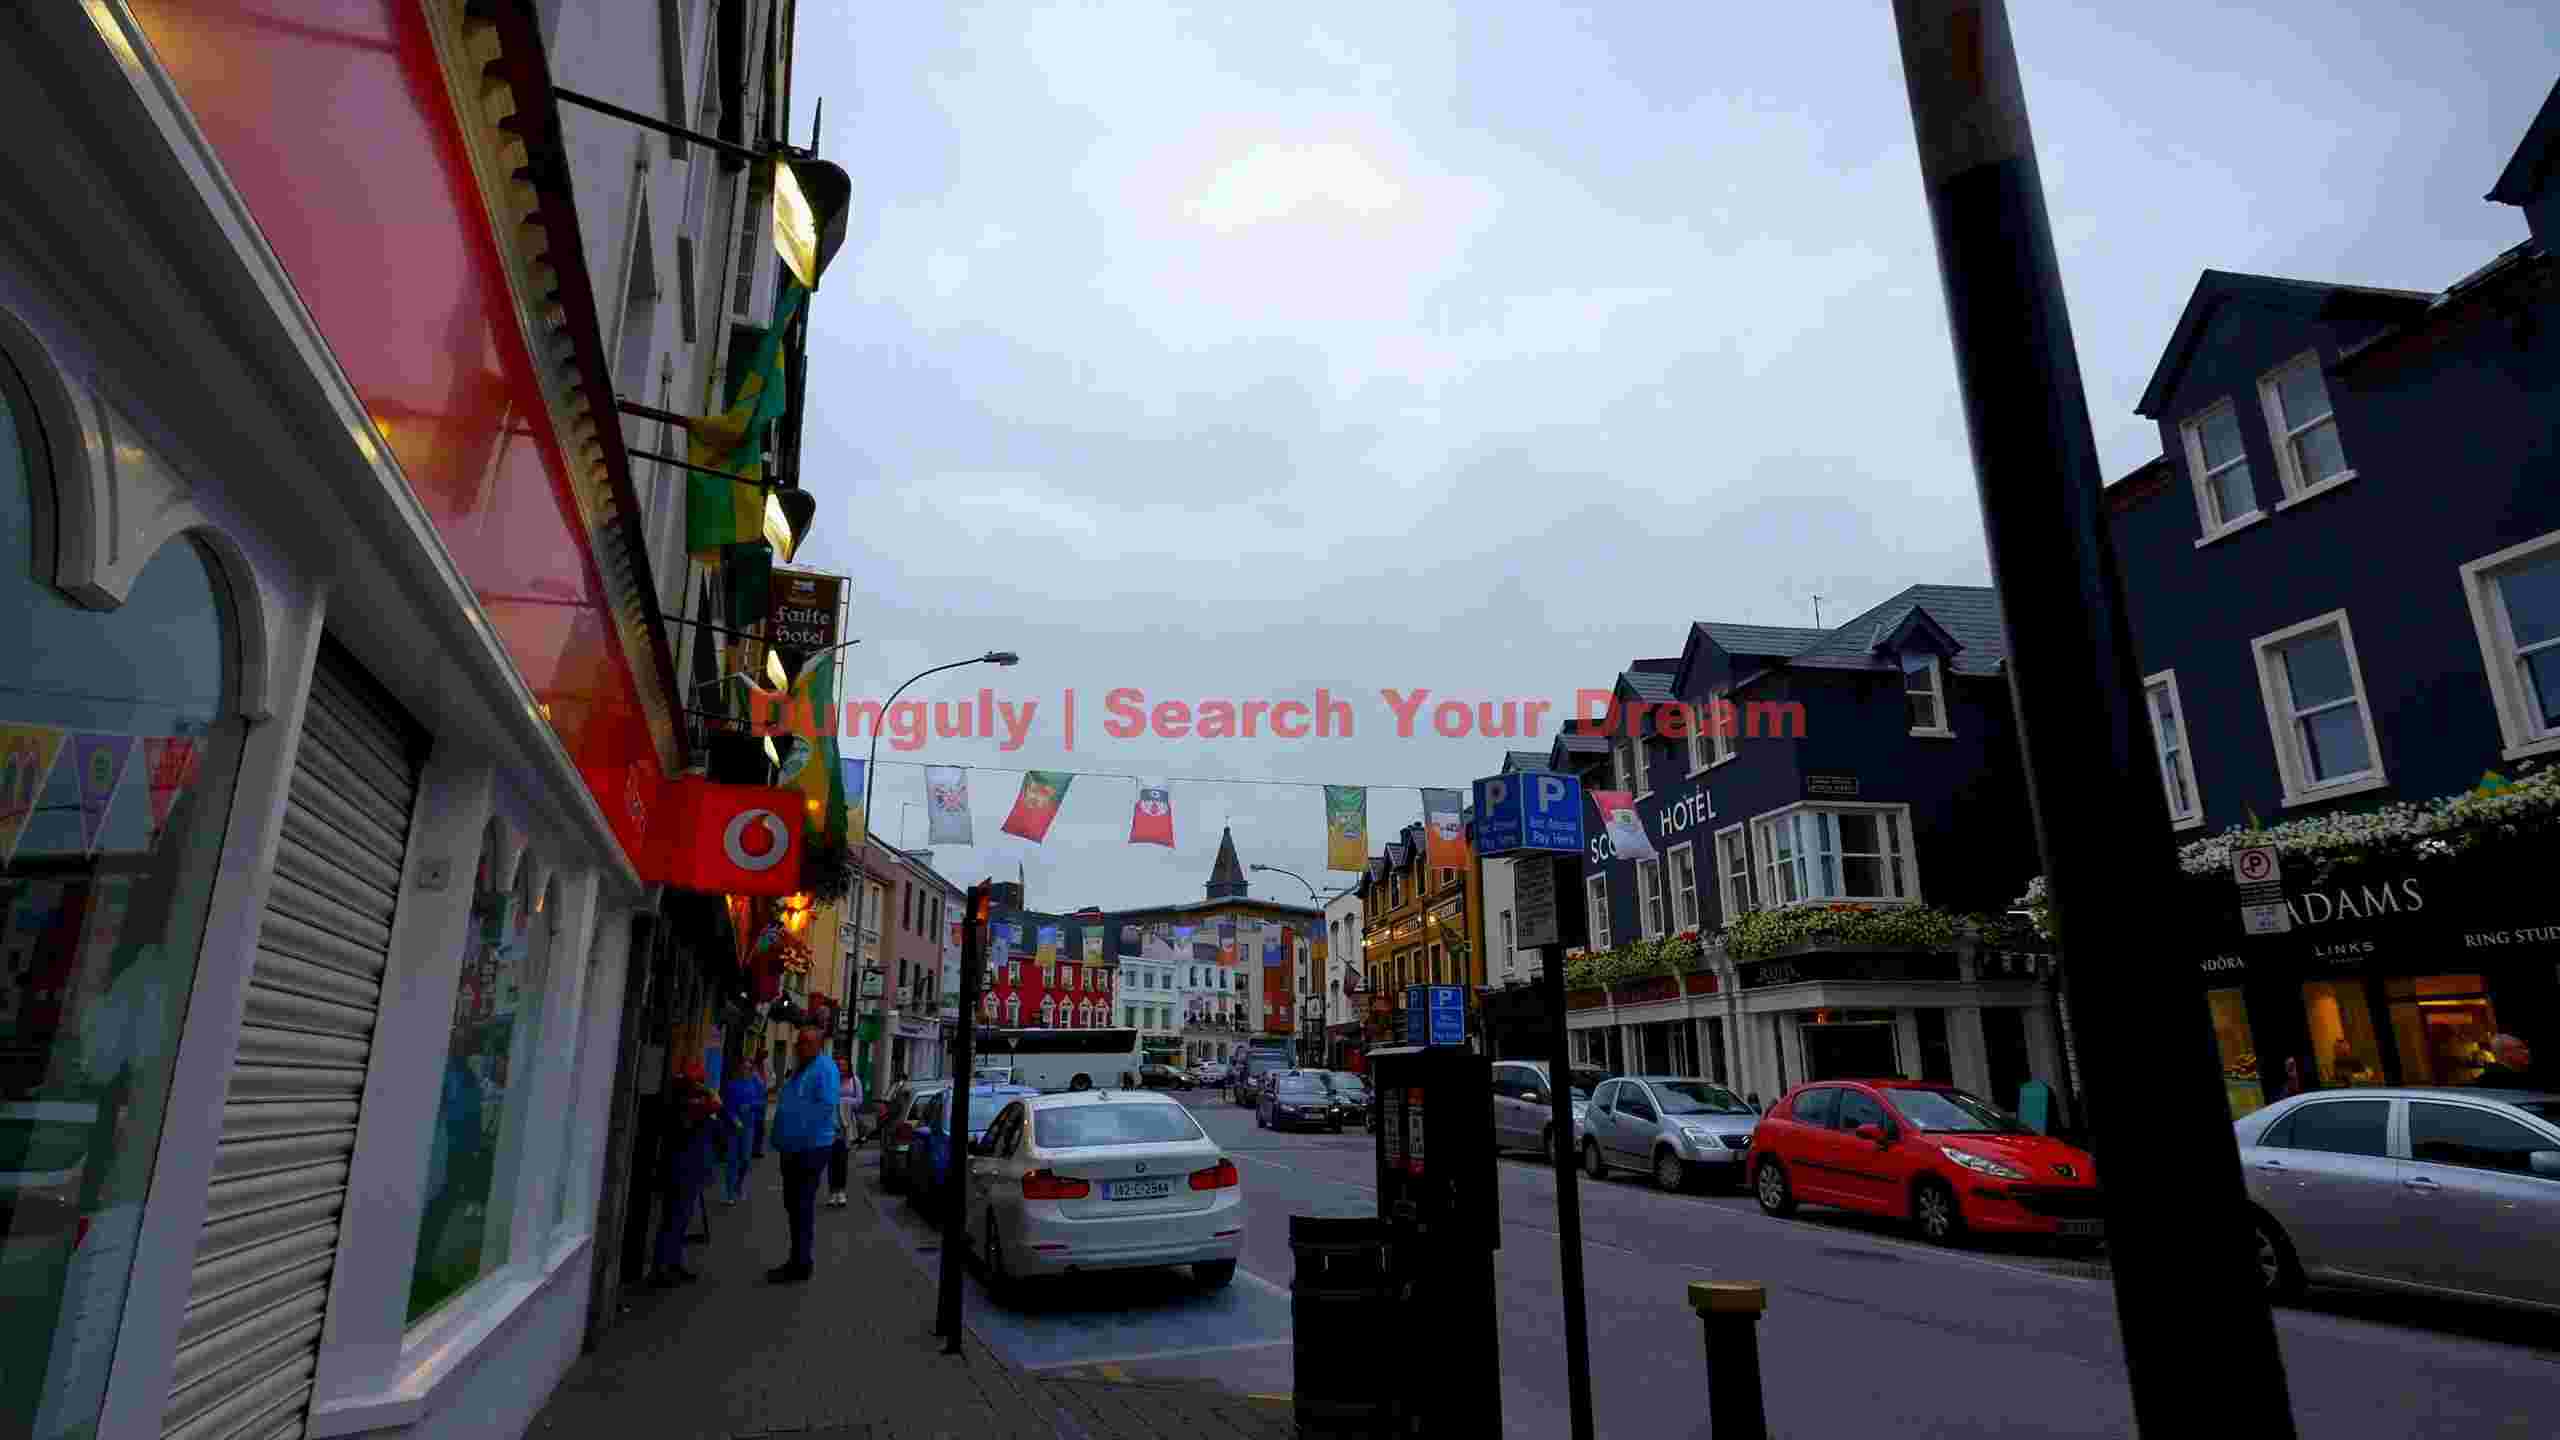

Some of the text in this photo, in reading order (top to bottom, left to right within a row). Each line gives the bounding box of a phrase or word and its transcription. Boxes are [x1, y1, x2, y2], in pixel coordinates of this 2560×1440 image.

[775, 624, 825, 645] Hotel
[1537, 776, 1566, 812] P
[1659, 790, 1717, 837] HOTEL
[2312, 940, 2376, 957] LINKS
[2464, 930, 2511, 949] RING
